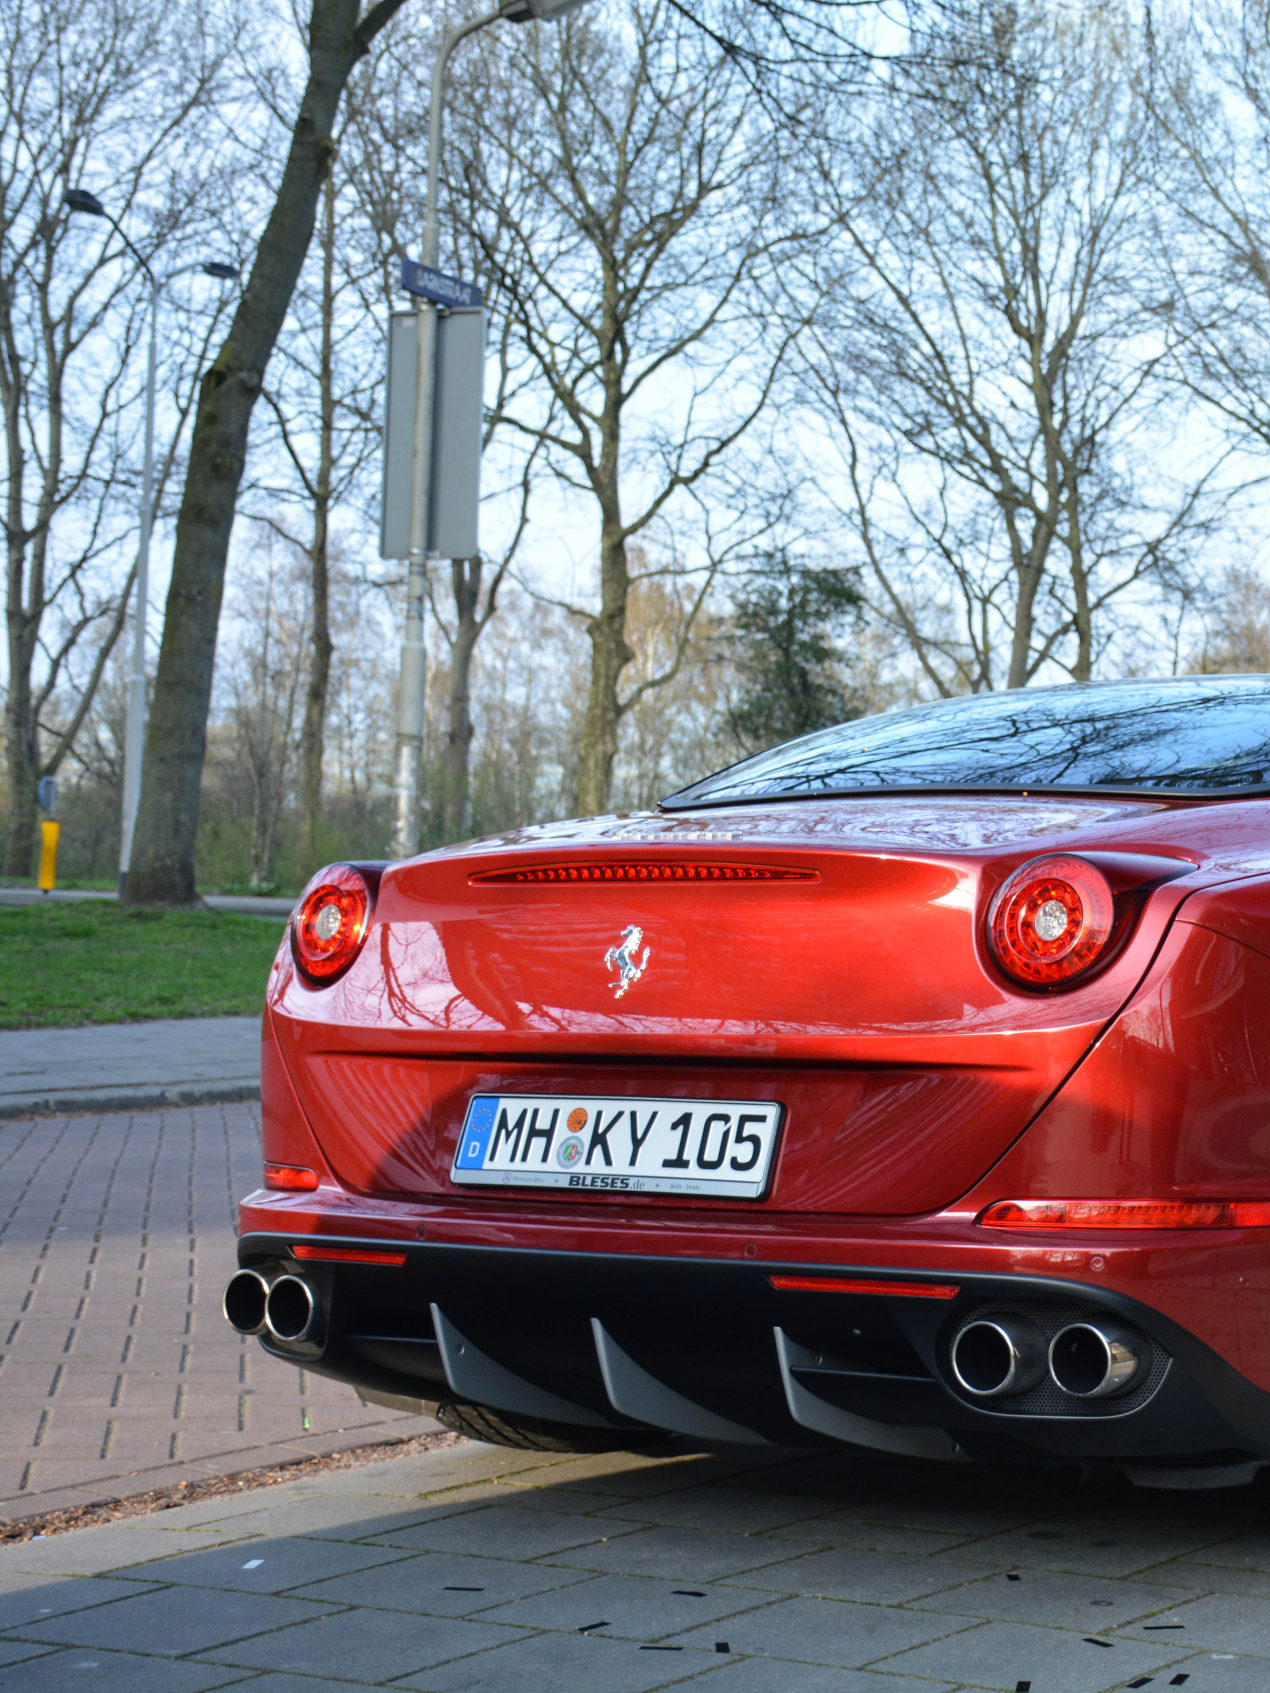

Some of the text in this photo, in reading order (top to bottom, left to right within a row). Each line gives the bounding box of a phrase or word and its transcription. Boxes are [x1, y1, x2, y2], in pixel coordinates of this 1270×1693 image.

[488, 1107, 561, 1163] MH
[584, 1110, 660, 1167] KY
[661, 1112, 768, 1172] 105
[468, 1141, 480, 1157] D
[568, 1175, 646, 1190] BLESES.de
